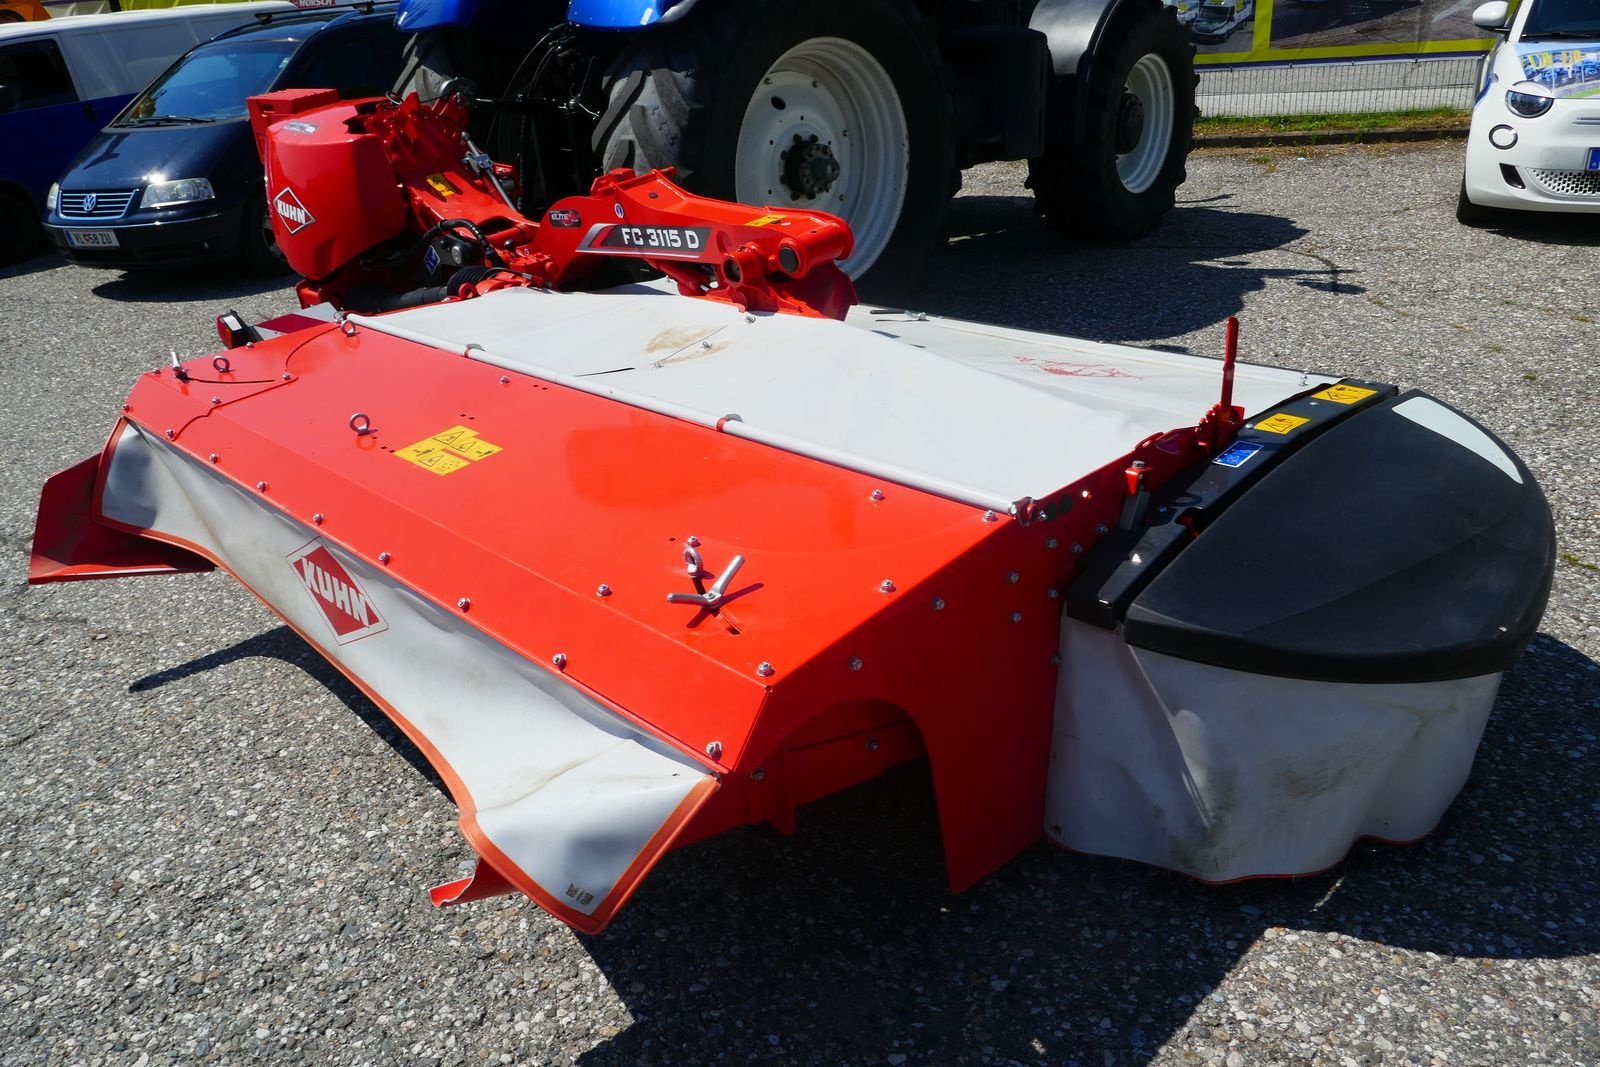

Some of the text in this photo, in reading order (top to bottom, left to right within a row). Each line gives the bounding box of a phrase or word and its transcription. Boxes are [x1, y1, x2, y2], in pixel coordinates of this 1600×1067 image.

[277, 199, 306, 225] KUHN
[621, 227, 699, 249] FC 3115 D
[301, 556, 370, 628] KUHN
